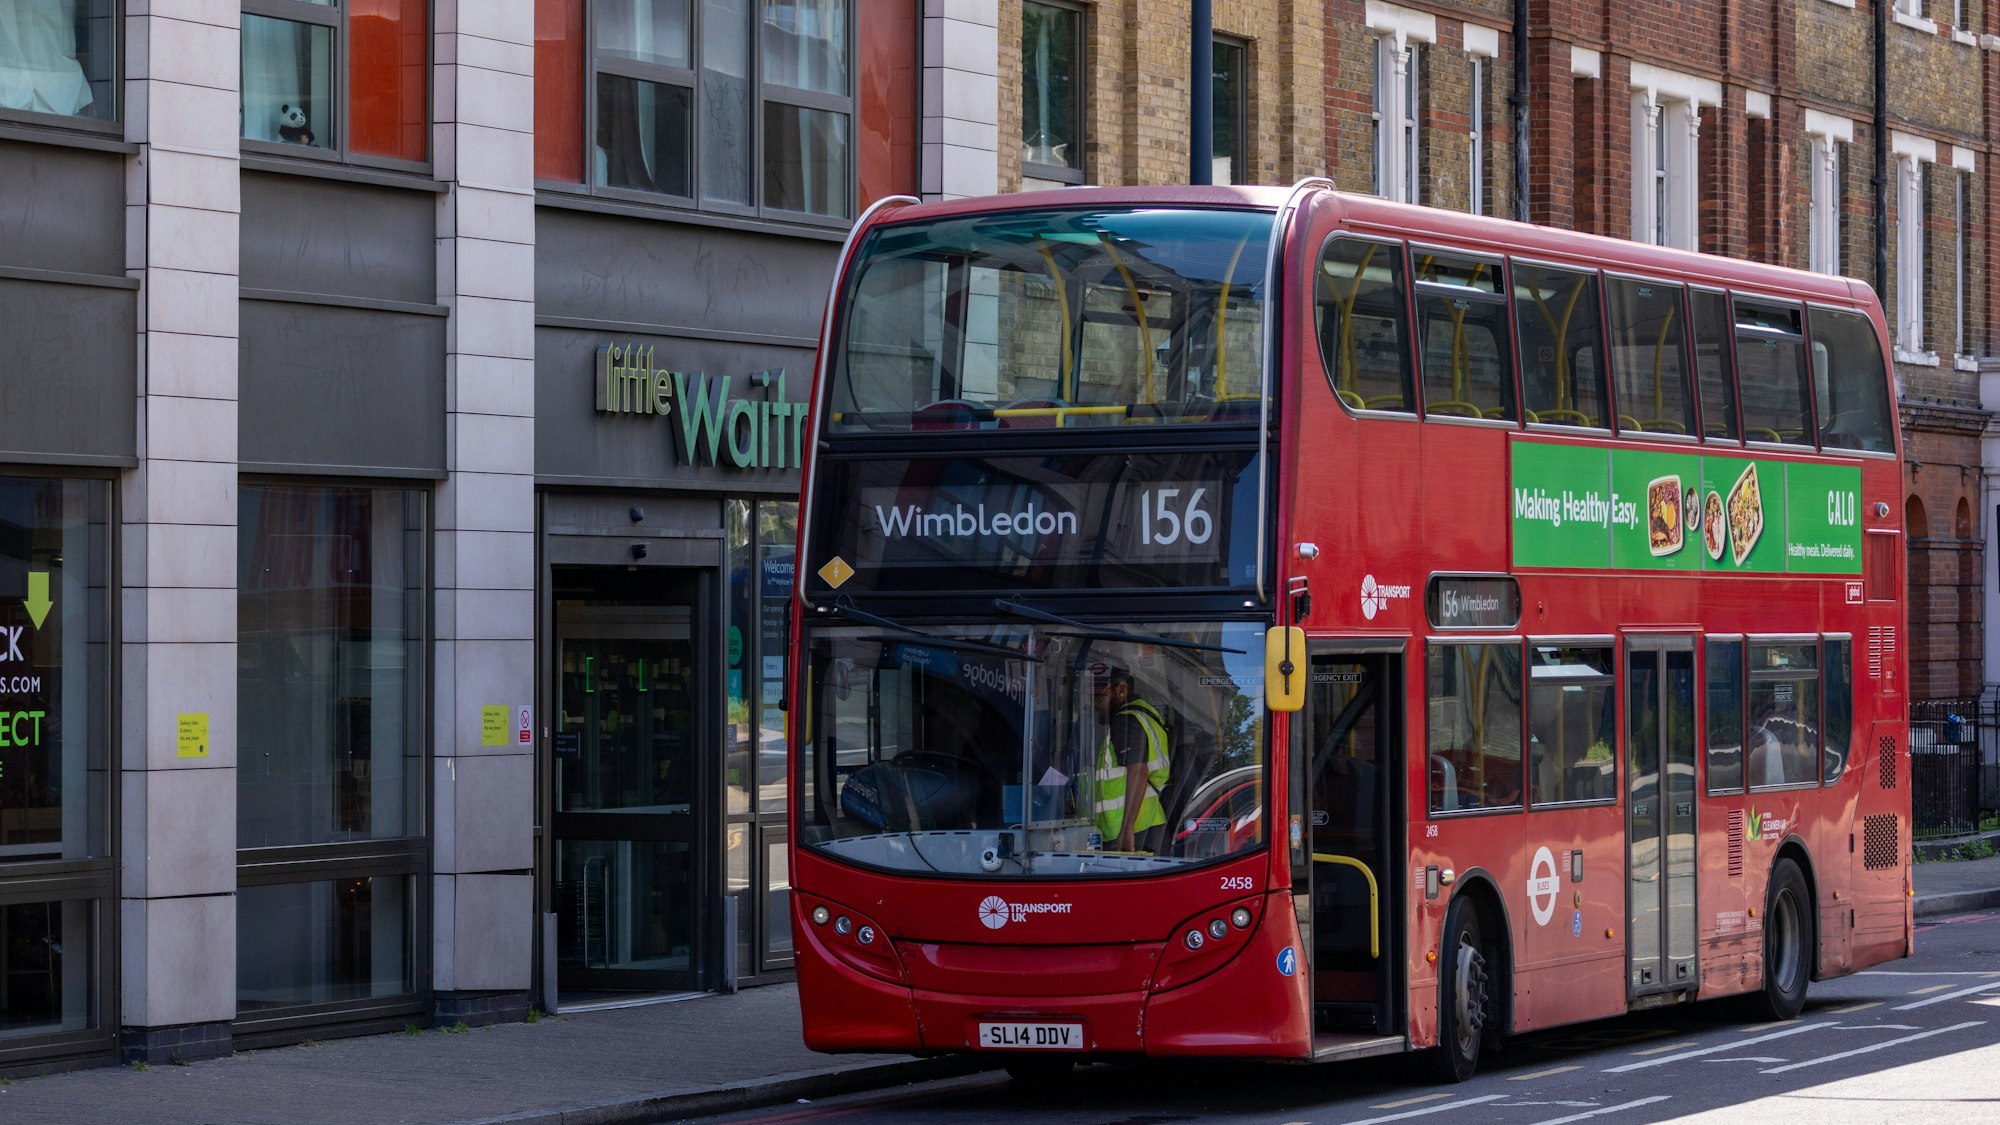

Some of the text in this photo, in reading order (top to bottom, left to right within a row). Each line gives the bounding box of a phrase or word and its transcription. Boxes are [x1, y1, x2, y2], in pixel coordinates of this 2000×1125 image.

[606, 341, 808, 468] little Waitr
[875, 487, 1213, 545] Wimbledon 156
[1515, 487, 1639, 530] Making Healthy Easy.
[1828, 490, 1855, 527] CALO
[1788, 542, 1855, 560] Healthy meals. Delivered daily.
[763, 560, 795, 574] Welcome
[1377, 585, 1411, 598] TRANSPORT
[1379, 598, 1388, 611] UK
[1442, 590, 1499, 618] 156 Wimbledon
[0, 711, 45, 747] ECT
[1426, 825, 1438, 838] 2458
[1220, 876, 1253, 890] 2458
[1009, 903, 1072, 913] TRANSPORT
[1011, 912, 1027, 923] UK
[991, 1026, 1070, 1045] SL14 DDV
